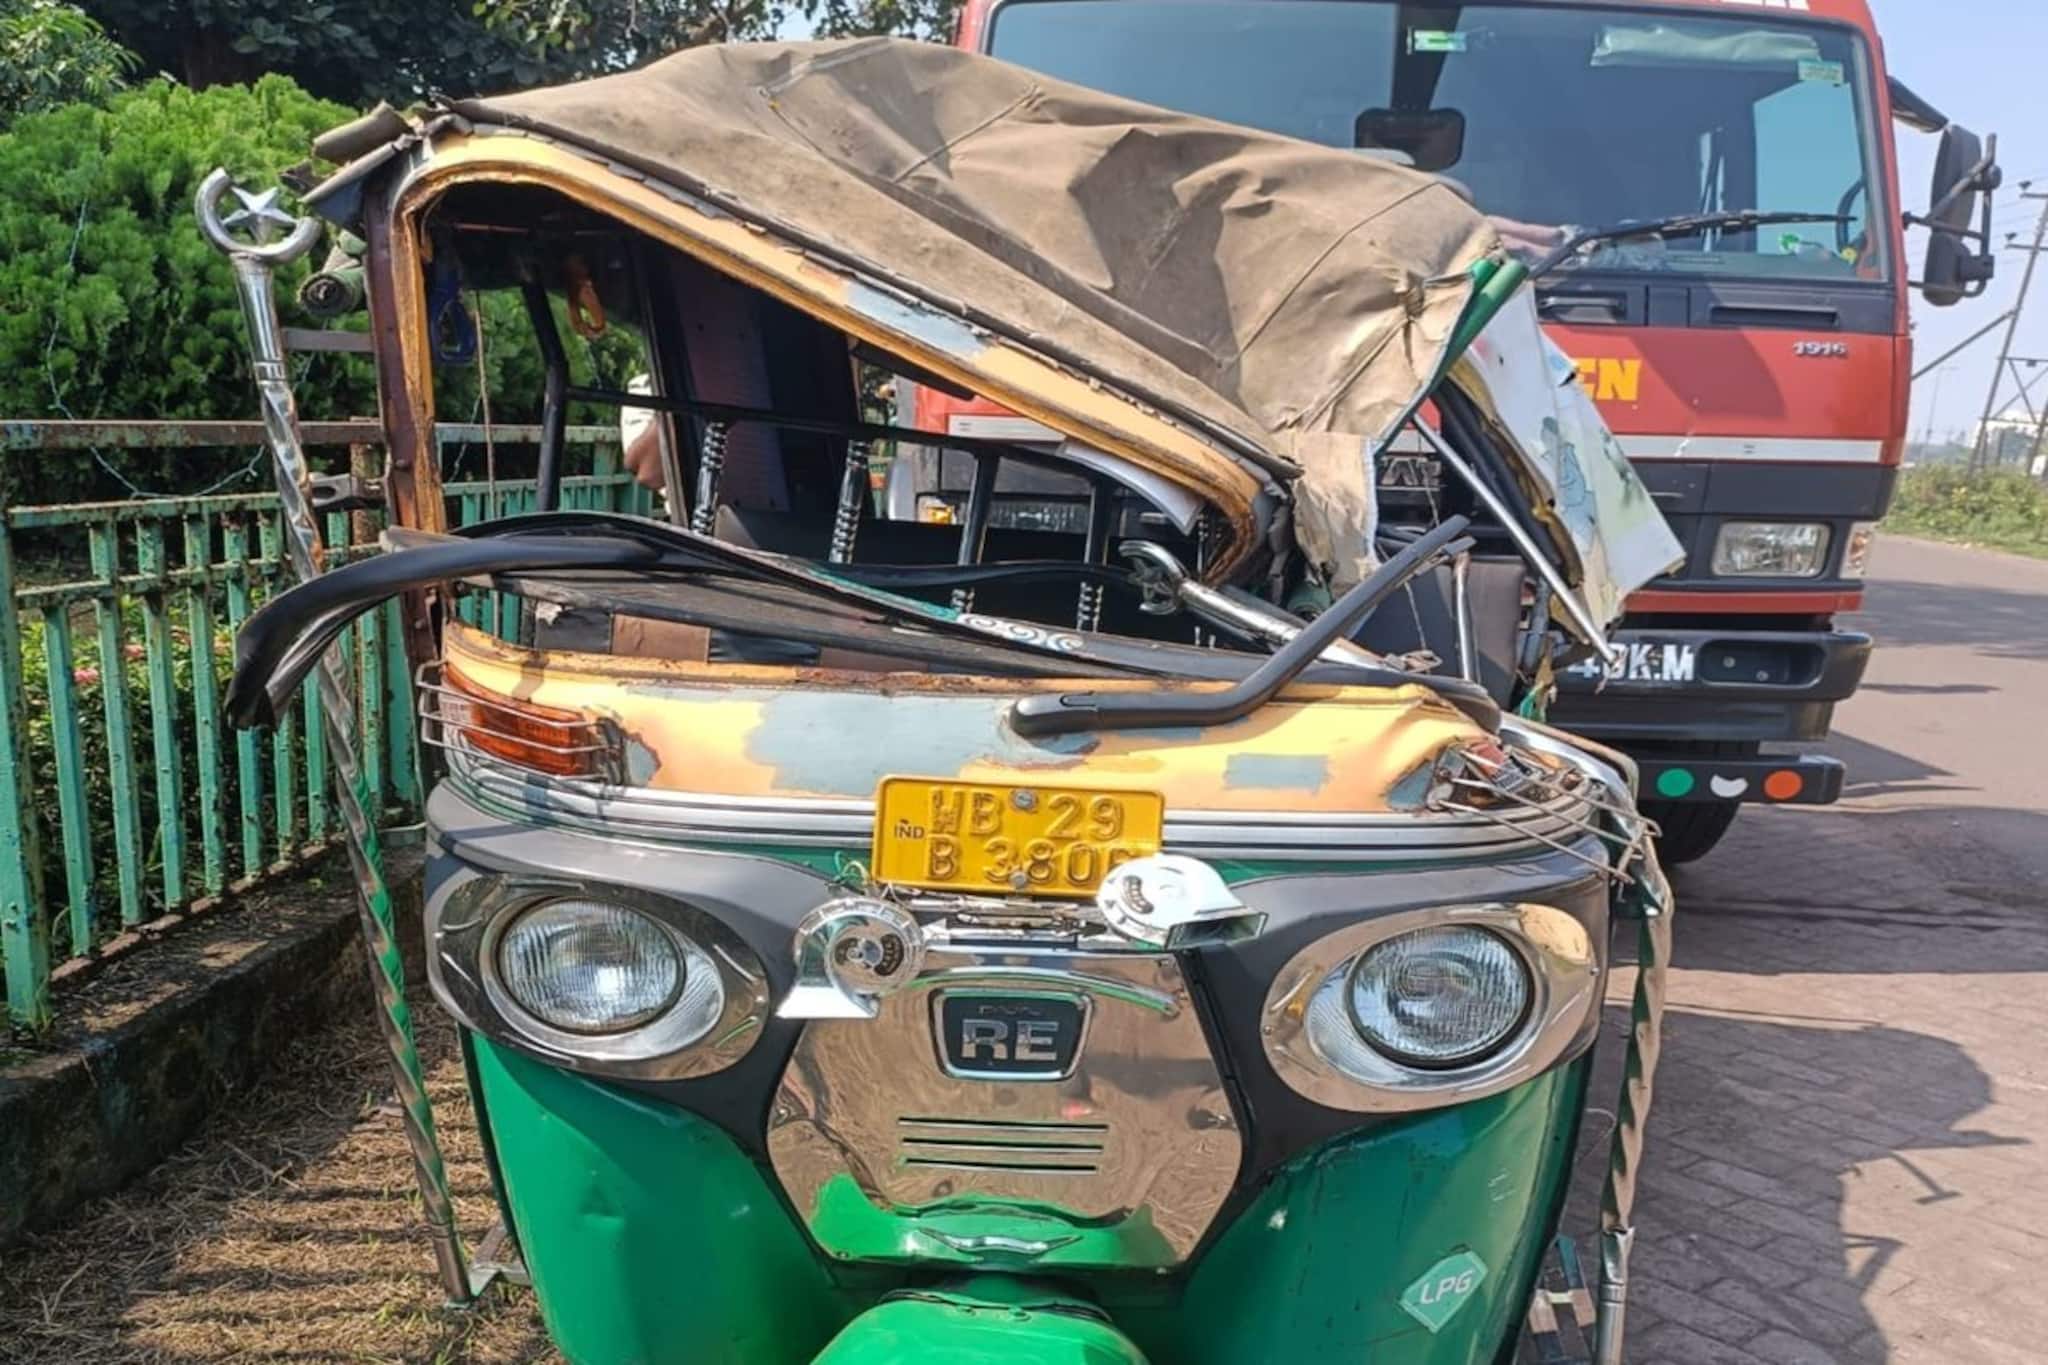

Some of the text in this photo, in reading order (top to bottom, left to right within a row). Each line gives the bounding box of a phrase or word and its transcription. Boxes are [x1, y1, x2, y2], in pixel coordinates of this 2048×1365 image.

[895, 825, 925, 839] IND
[1047, 793, 1124, 842] 29
[926, 835, 959, 880] B
[961, 1018, 1059, 1061] RE
[1420, 1270, 1474, 1304] LPG
